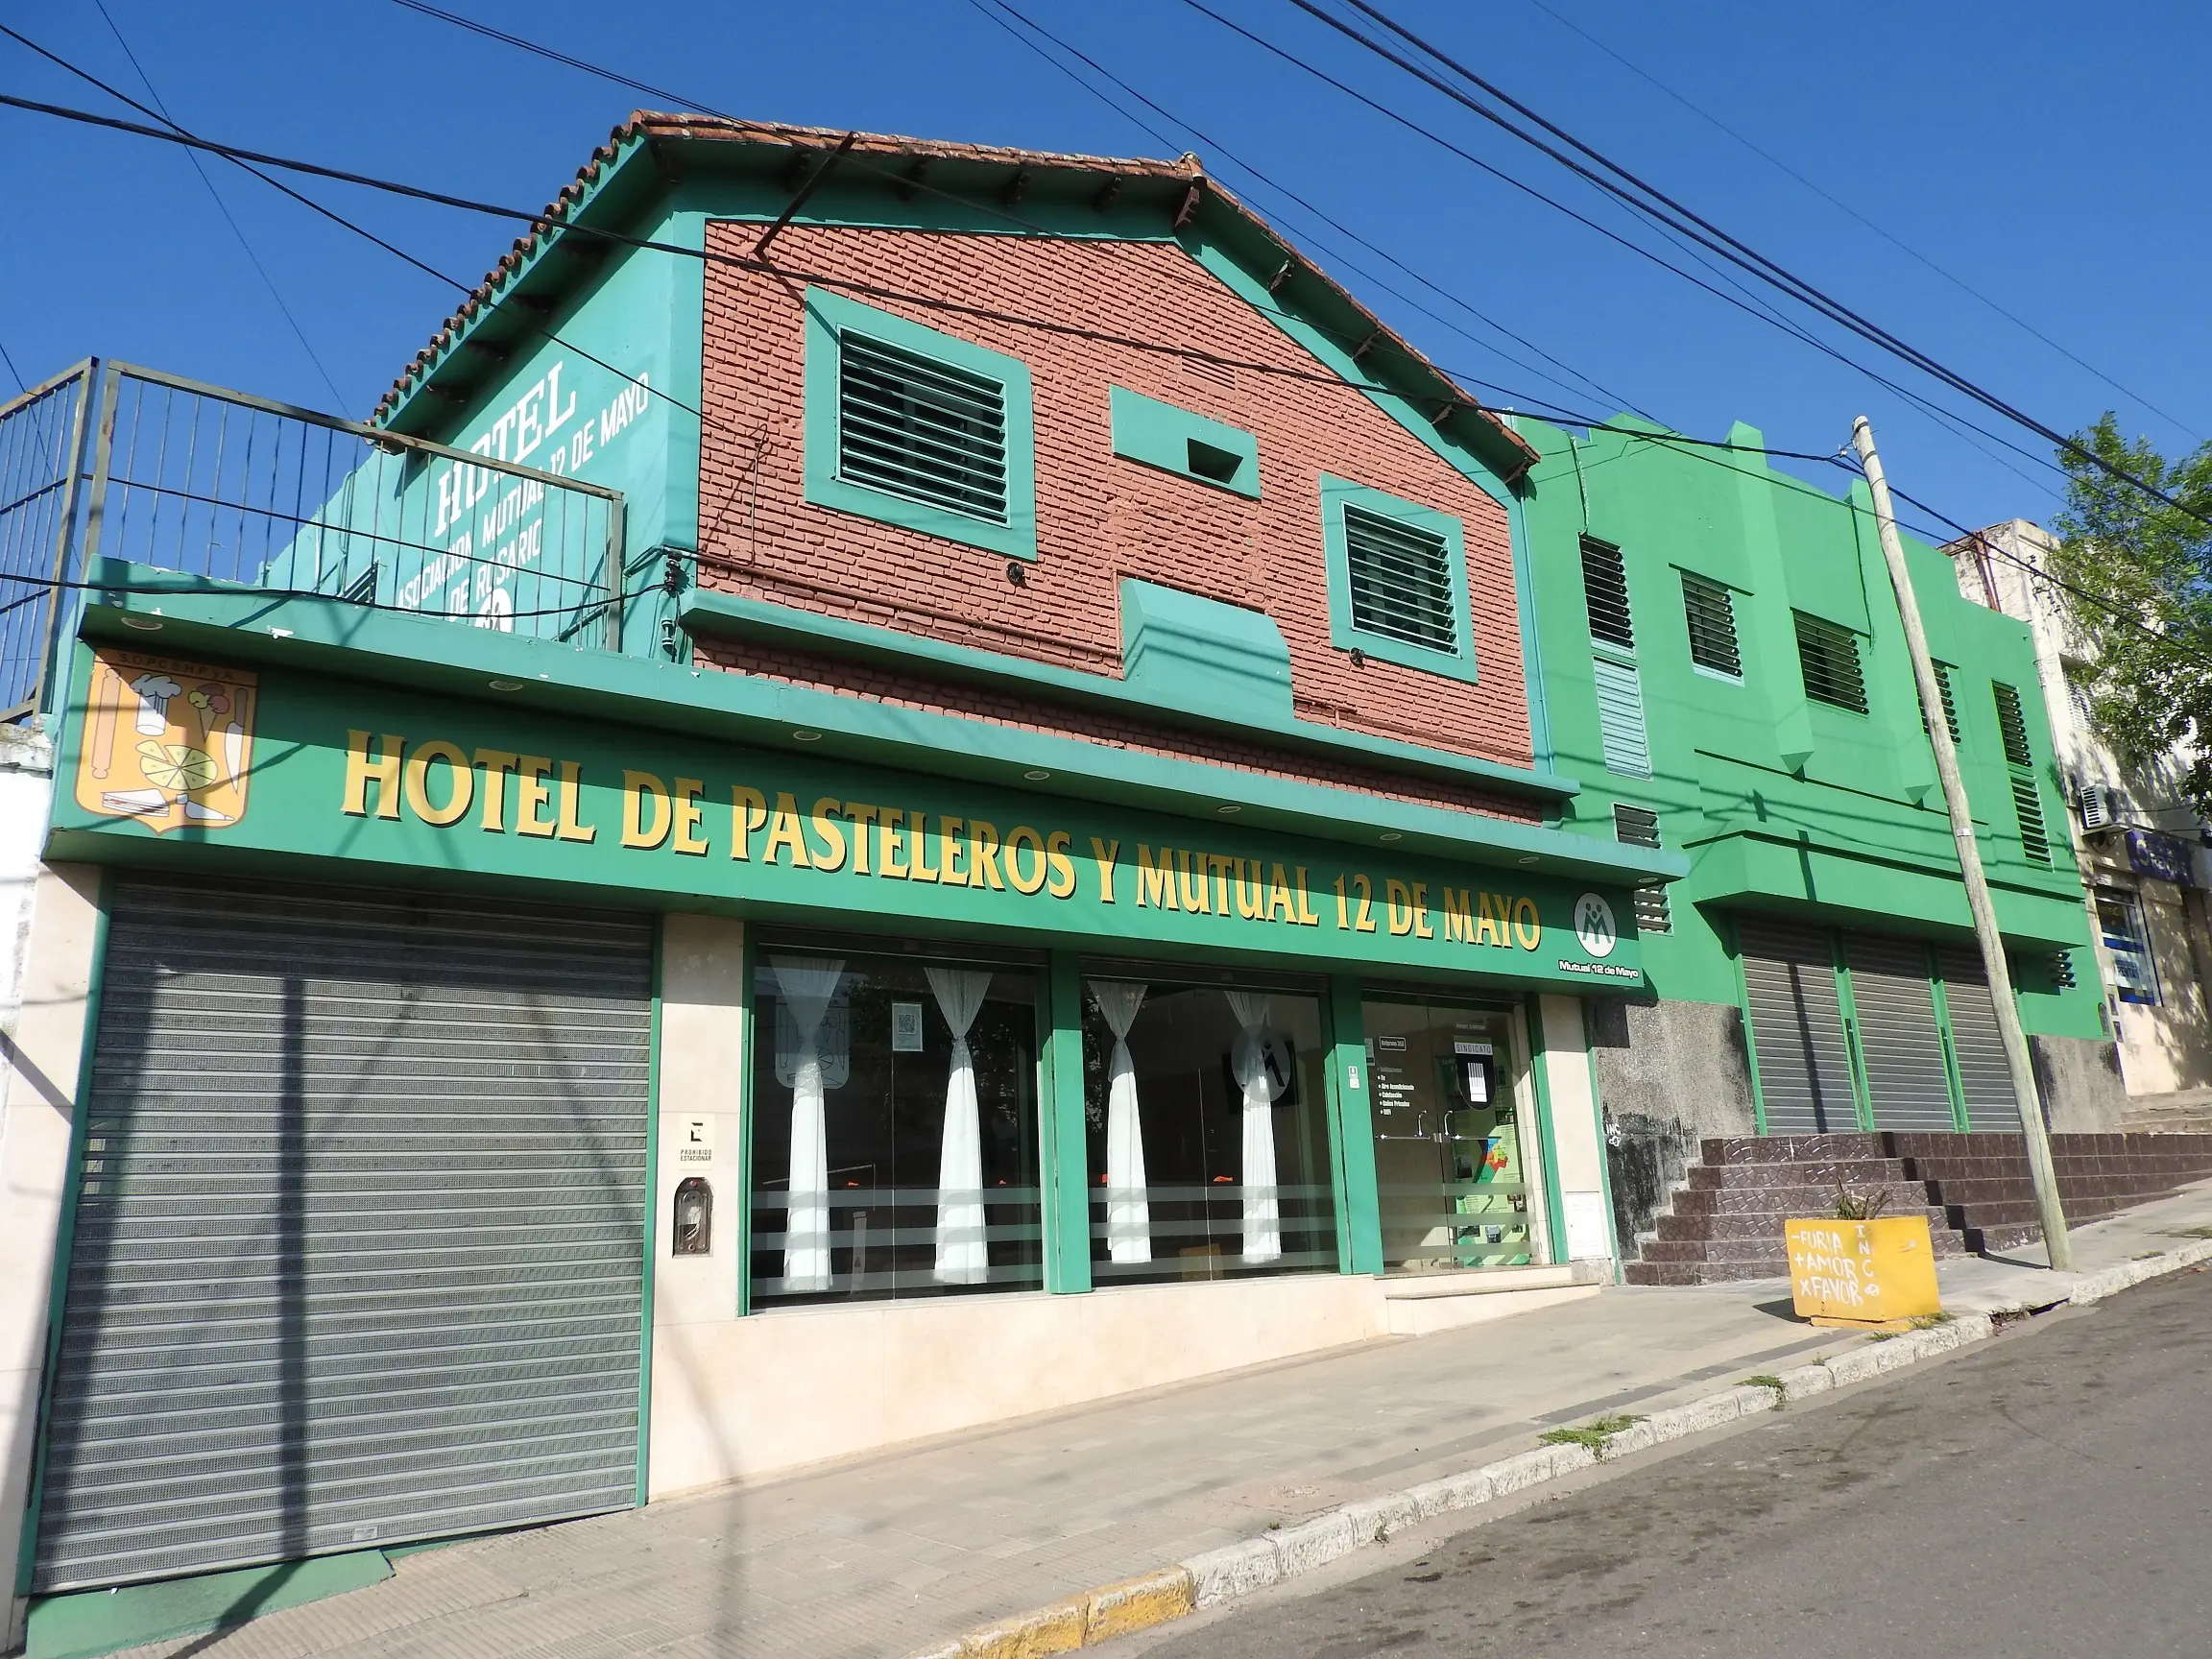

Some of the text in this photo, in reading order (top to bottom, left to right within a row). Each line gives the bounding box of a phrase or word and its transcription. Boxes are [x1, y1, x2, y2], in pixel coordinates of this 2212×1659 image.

[435, 360, 576, 538] HOTEL
[482, 467, 545, 548] MUTUAL
[550, 445, 566, 490] 12
[571, 419, 595, 472] DE
[600, 372, 650, 447] MAYO
[448, 578, 470, 622] DE
[341, 729, 1542, 952] HOTEL DE PASTELEROS Y MUTUAL 12 DE MAYO
[1559, 960, 1638, 978] Mutual 12 de Mayo
[1455, 1044, 1491, 1053] SINDICATO
